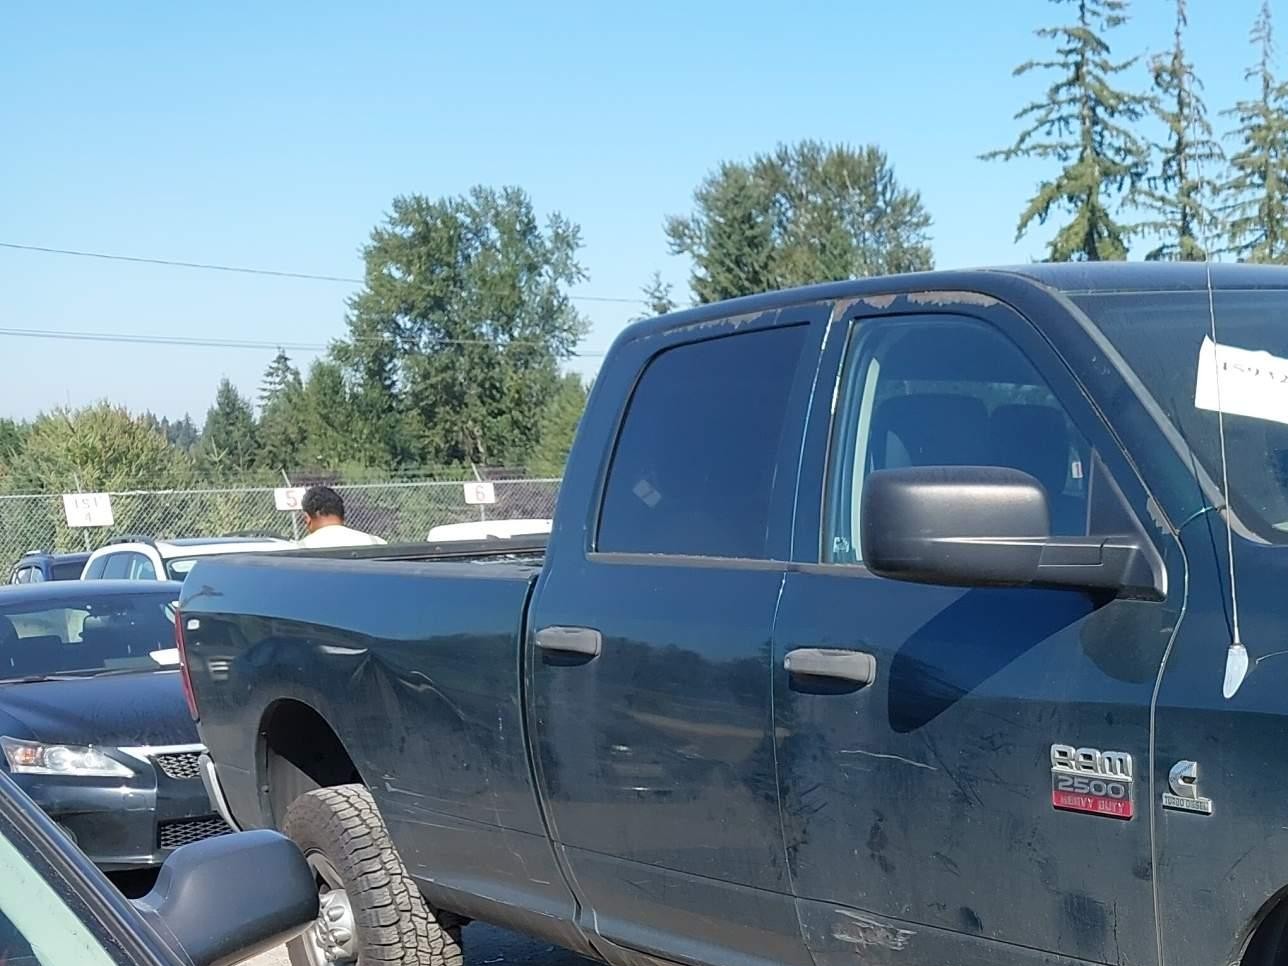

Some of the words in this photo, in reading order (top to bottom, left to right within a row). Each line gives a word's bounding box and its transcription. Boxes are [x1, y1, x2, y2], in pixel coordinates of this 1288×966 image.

[286, 490, 298, 508] 5
[1051, 743, 1133, 778] RAM
[1058, 775, 1125, 799] 2500
[1059, 794, 1095, 809] HEAVY
[1098, 799, 1125, 815] DUTY
